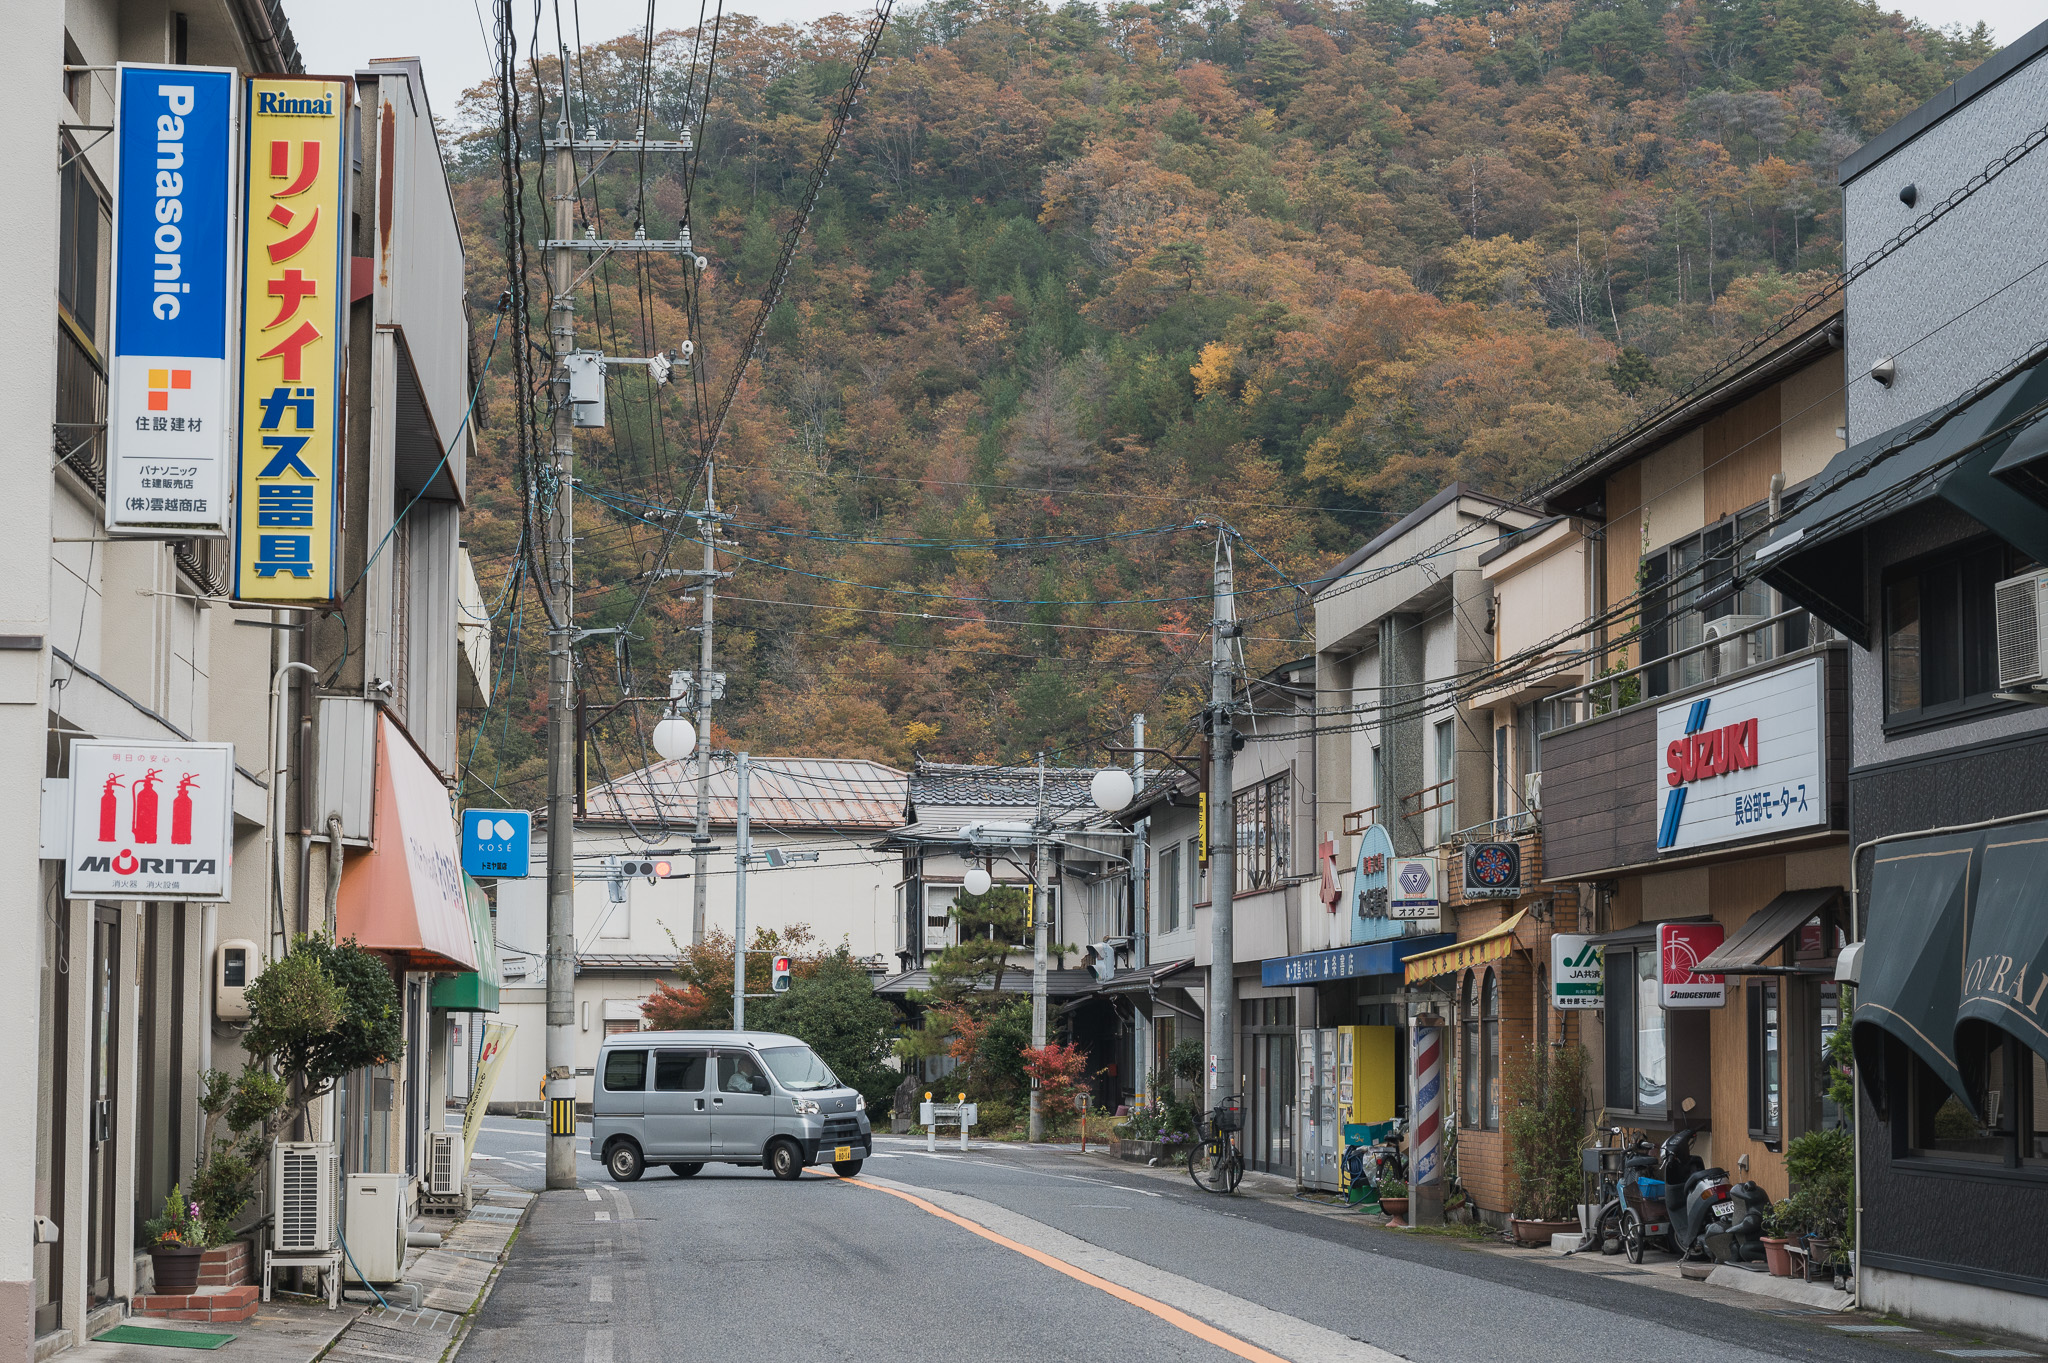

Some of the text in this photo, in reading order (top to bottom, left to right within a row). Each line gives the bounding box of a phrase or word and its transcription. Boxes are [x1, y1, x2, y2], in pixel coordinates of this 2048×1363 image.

[258, 91, 334, 117] Rinnai
[152, 85, 195, 320] Panasonic
[136, 416, 202, 432] 住設建材
[141, 478, 194, 489] 住建販売店
[1667, 718, 1758, 787] SUZUKI
[1735, 784, 1808, 826] 長谷部モータース
[478, 843, 512, 852] KOSÉ
[78, 849, 216, 875] MORITA
[1399, 908, 1435, 916] オオタニ
[1670, 990, 1721, 999] BRIDGESTONE
